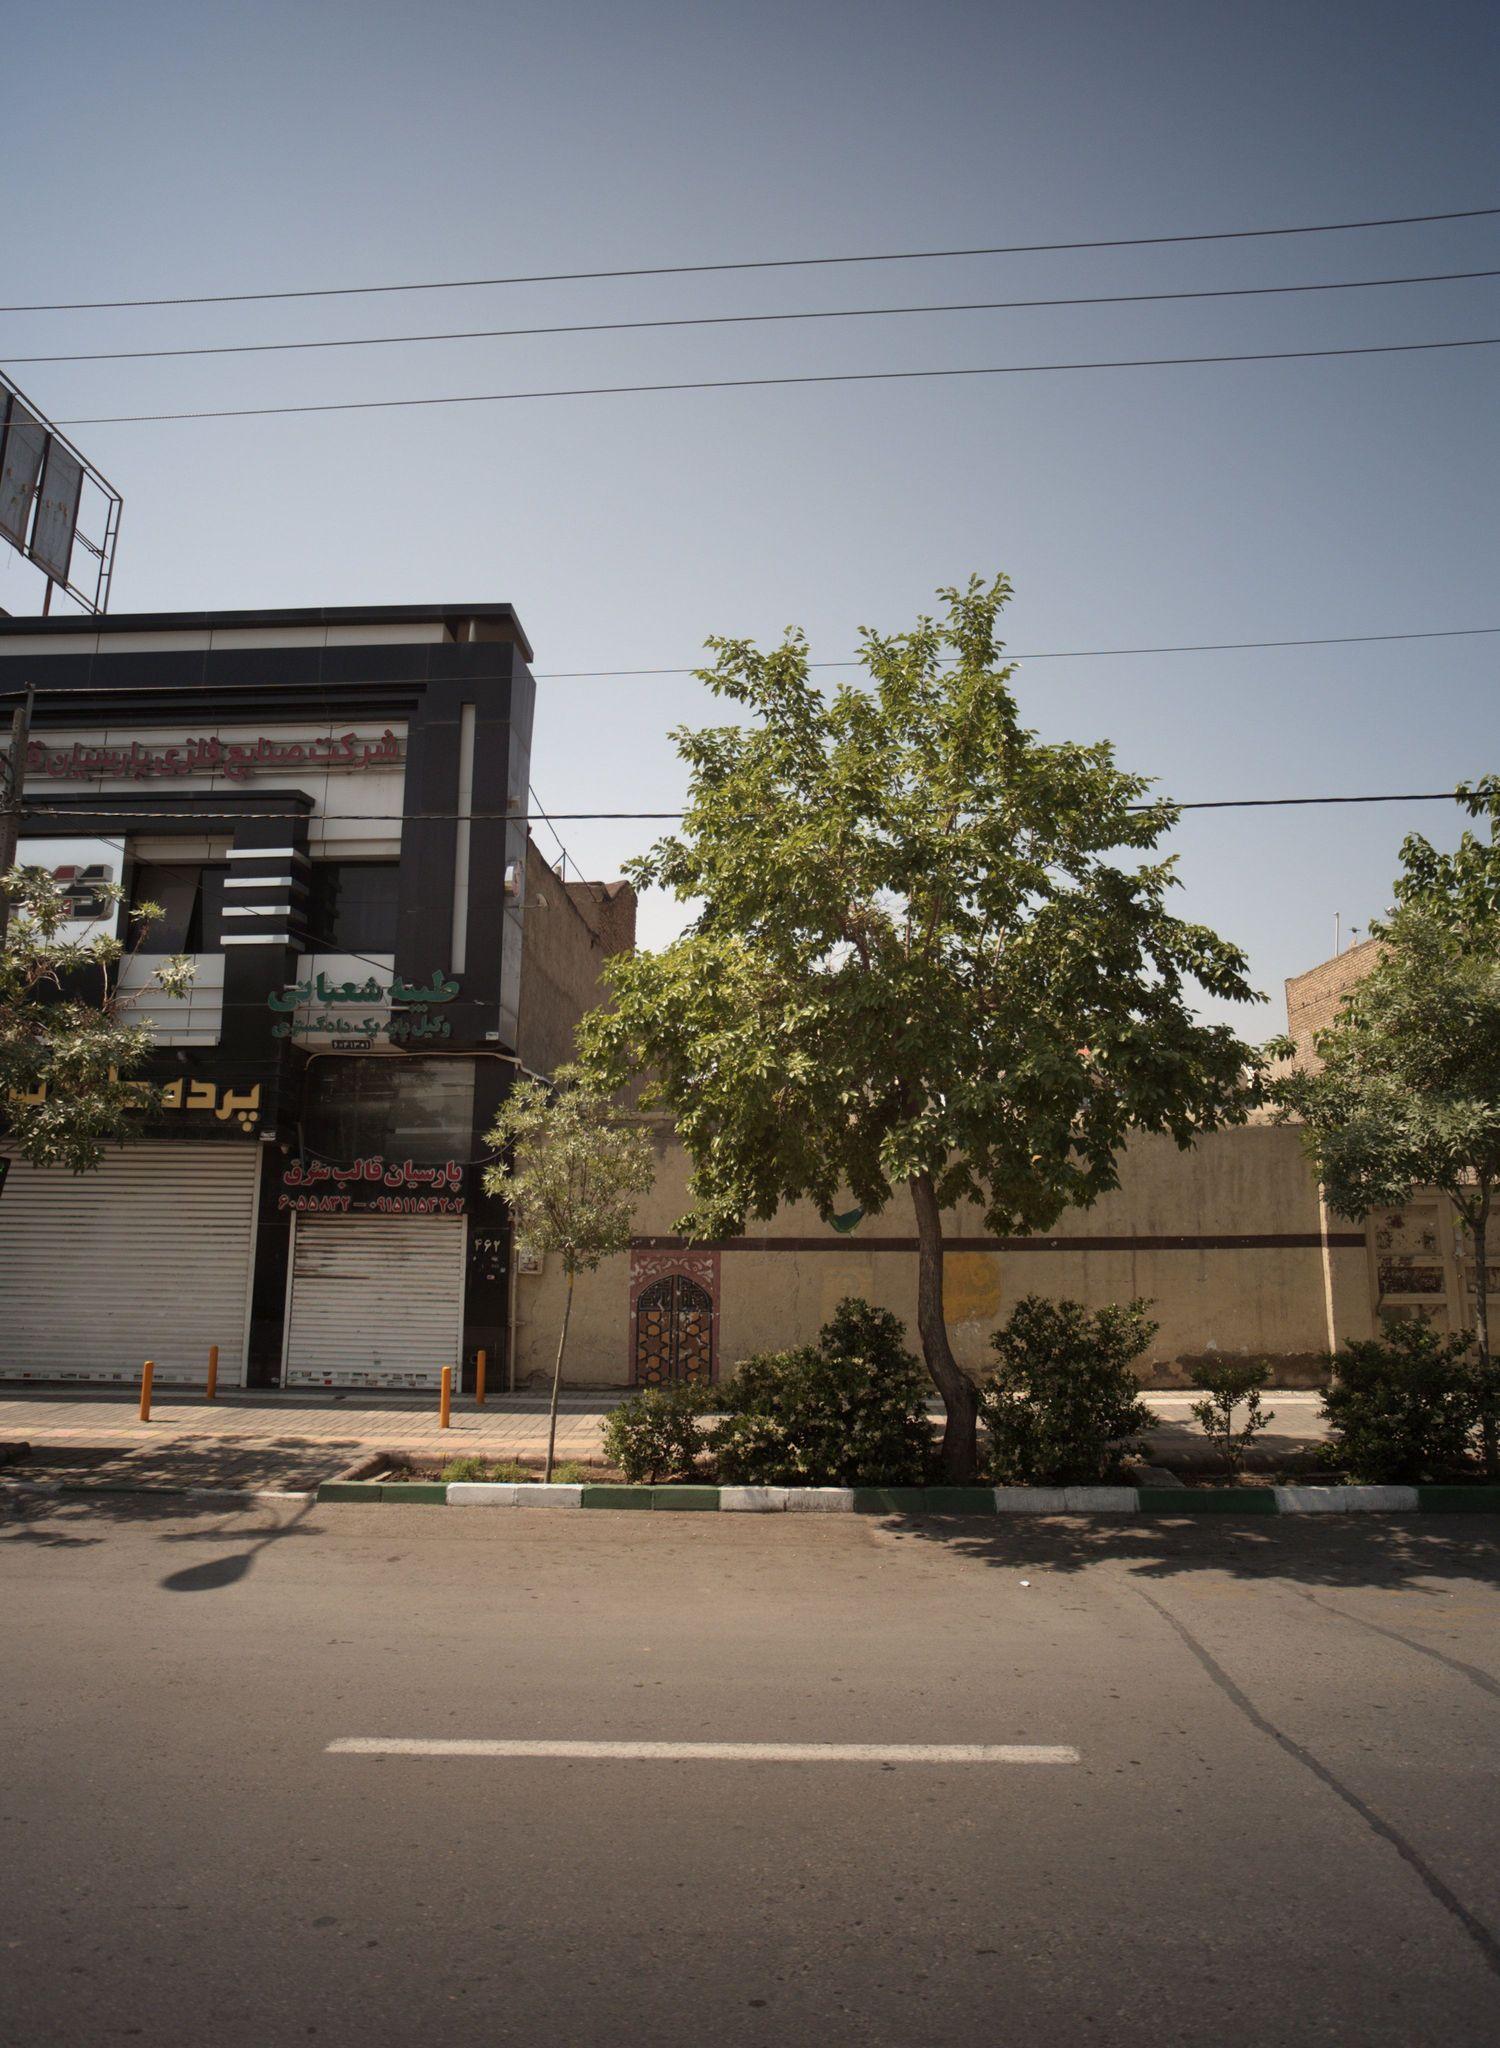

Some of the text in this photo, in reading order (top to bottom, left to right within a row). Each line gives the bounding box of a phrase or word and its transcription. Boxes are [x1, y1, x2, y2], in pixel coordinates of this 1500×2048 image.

[45, 740, 150, 781] پارسیان
[153, 736, 223, 775] فلزی
[223, 736, 306, 781] صنایع
[308, 728, 399, 769] شرکت
[267, 970, 384, 1012] شعبانی
[411, 1014, 452, 1039] وکیل
[283, 1155, 463, 1193] پارسیان قالب شرق
